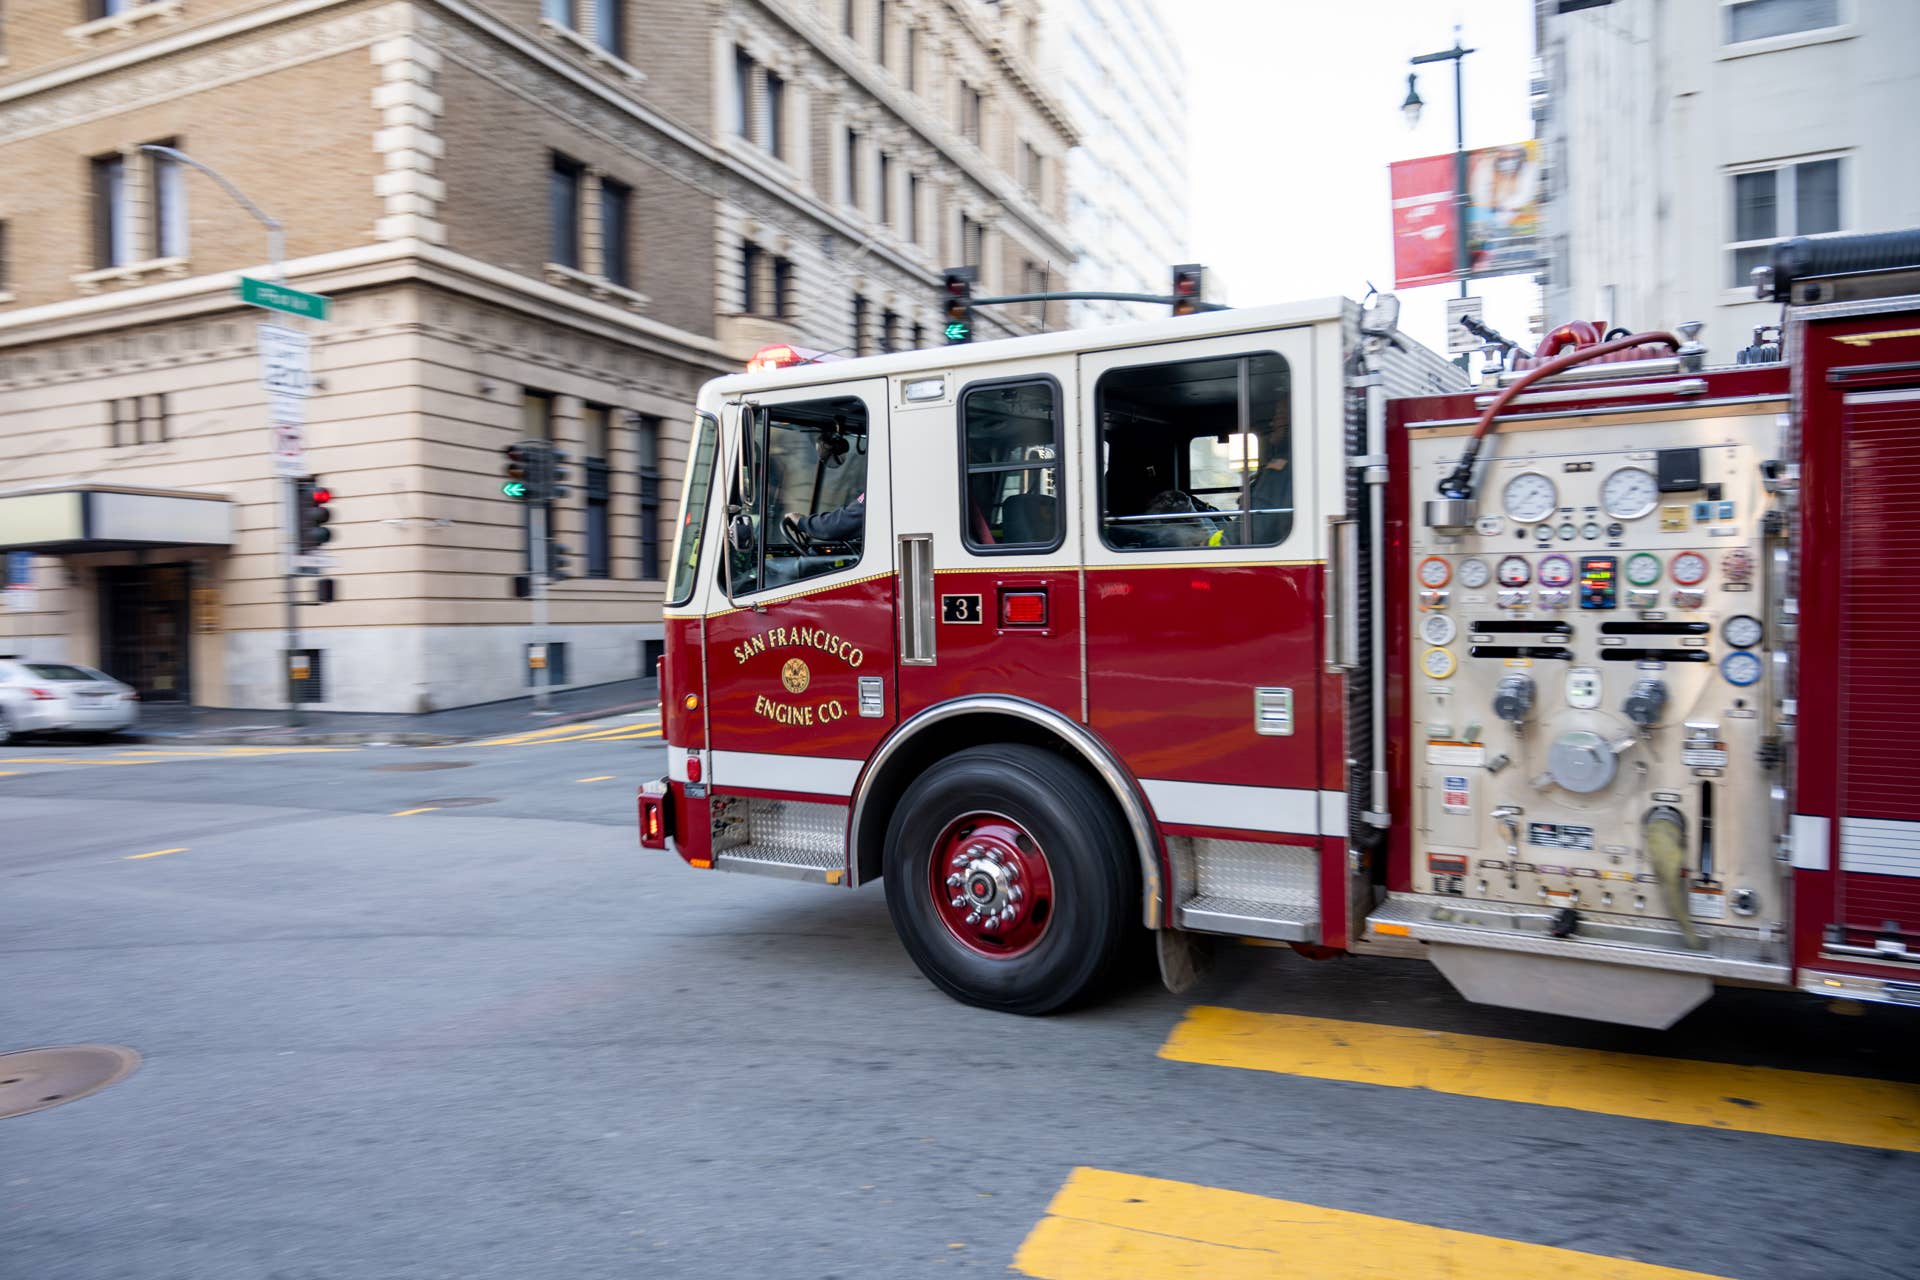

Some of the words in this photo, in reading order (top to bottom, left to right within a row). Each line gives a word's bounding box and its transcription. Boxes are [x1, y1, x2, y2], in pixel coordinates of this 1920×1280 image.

[955, 598, 969, 620] 3
[733, 633, 766, 665] SAN
[768, 626, 864, 668] FRANCISCO
[754, 694, 814, 726] ENGINE
[818, 700, 848, 723] CO.
